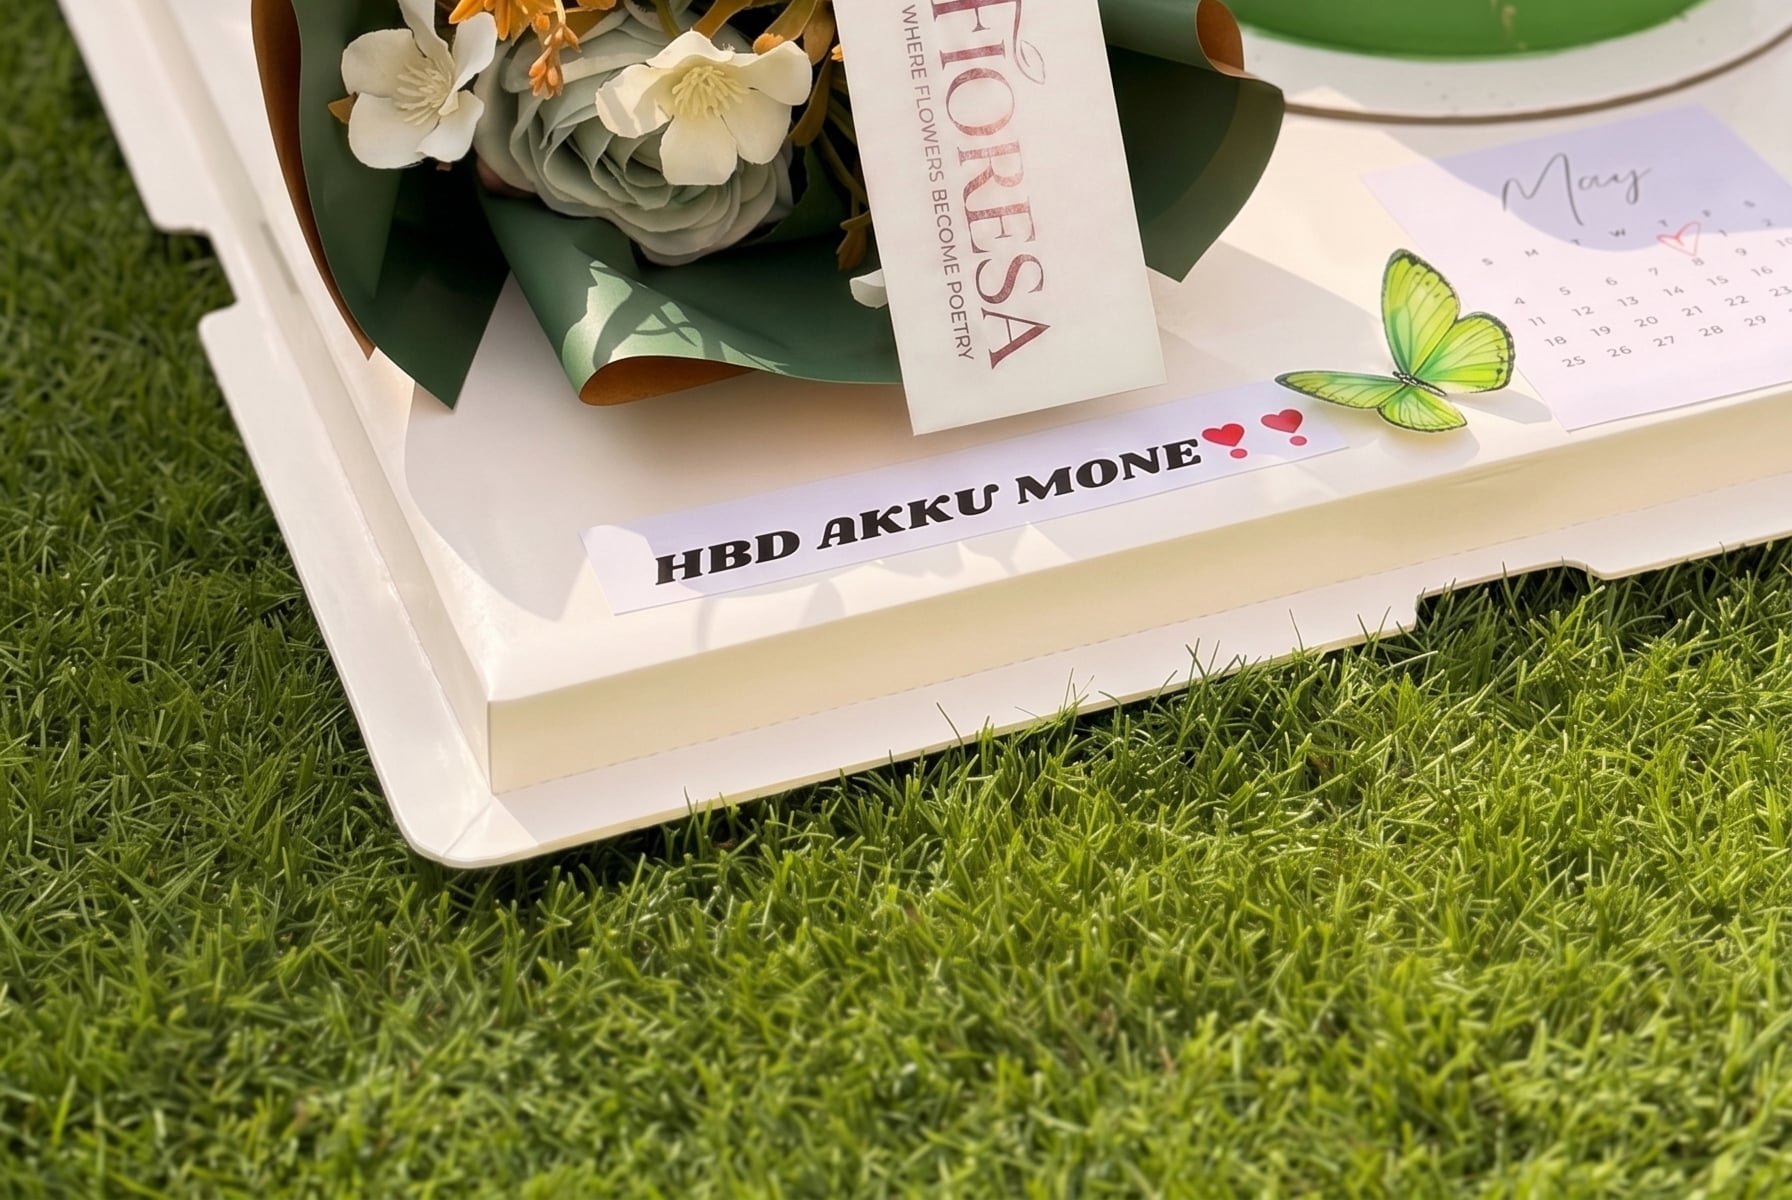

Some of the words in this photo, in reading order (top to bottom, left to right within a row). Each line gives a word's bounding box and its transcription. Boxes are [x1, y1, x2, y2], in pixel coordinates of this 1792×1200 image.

[902, 4, 927, 80] WHERE
[915, 85, 944, 182] FLOWERS
[932, 189, 960, 275] BECOME
[947, 281, 974, 359] POETRY
[1501, 152, 1653, 227] May
[1514, 296, 1526, 305] 4
[1558, 286, 1572, 296] 5
[1605, 276, 1618, 286] 6
[1647, 266, 1659, 277] 7
[1690, 256, 1705, 267] 8
[1735, 247, 1748, 257] 9
[1527, 316, 1546, 327] 11
[1571, 305, 1595, 317] 12
[1616, 295, 1639, 307] 13
[1662, 285, 1685, 297] 14
[1706, 275, 1729, 286] 15
[1750, 265, 1774, 277] 16
[1544, 335, 1568, 347] 18
[1590, 325, 1611, 337] 19
[1634, 315, 1659, 328] 20
[1681, 305, 1703, 317] 21
[1724, 295, 1750, 307] 22
[1768, 285, 1792, 298] 23
[1561, 355, 1586, 368] 25
[1606, 345, 1633, 358] 26
[1652, 335, 1675, 348] 27
[1698, 325, 1724, 337] 28
[1743, 314, 1767, 328] 29
[656, 531, 799, 584] HBD
[817, 485, 998, 549] AKKU
[1016, 439, 1201, 504] MONE
